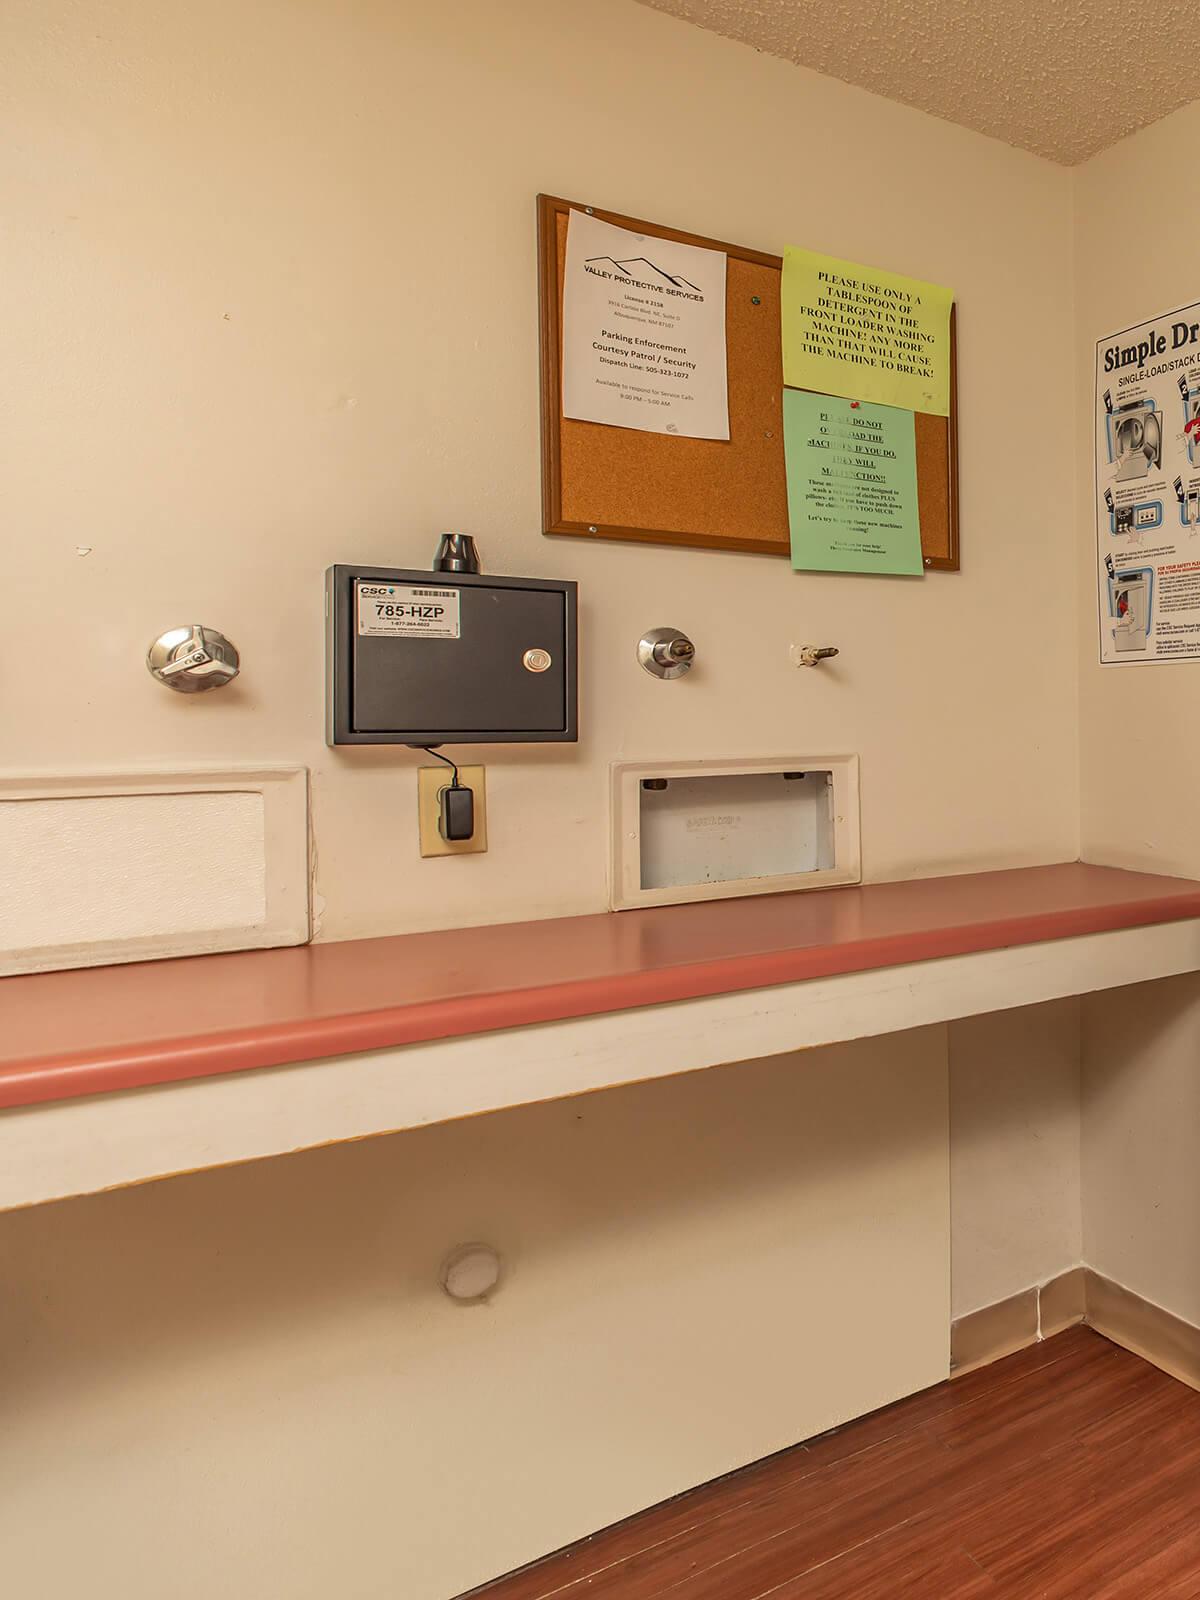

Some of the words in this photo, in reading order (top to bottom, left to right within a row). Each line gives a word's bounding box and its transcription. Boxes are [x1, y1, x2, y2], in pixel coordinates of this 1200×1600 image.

[584, 265, 612, 280] VALLEY
[614, 275, 664, 293] PROTECTIVE
[666, 288, 704, 302] SERVICES
[818, 272, 859, 289] PLEASE
[862, 282, 881, 295] USE
[884, 288, 912, 302] ONLY
[624, 294, 644, 304] License
[818, 297, 883, 320] DETERGENT
[886, 314, 896, 323] IN
[900, 317, 919, 328] THE
[826, 286, 896, 310] TABLESPOON
[899, 304, 912, 314] OF
[801, 306, 837, 321] FRONT
[841, 316, 884, 332] LOADER
[886, 325, 935, 343] WASHING
[812, 321, 866, 341] MACHINE!
[870, 335, 890, 345] ANY
[894, 339, 924, 353] MORE
[592, 342, 629, 357] Courtesy
[631, 350, 655, 361] Patrol
[663, 357, 696, 370] Security
[601, 330, 633, 344] Parking
[635, 338, 686, 354] Enforcement
[804, 331, 834, 345] THAN
[837, 338, 866, 352] THAT
[869, 346, 896, 359] WILL
[898, 352, 931, 366] CAUSE
[1104, 330, 1166, 372] Simple
[600, 356, 628, 368] Dispatch
[629, 363, 644, 371] Line:
[646, 366, 689, 379] 505-323-1072
[801, 343, 824, 356] THE
[827, 349, 877, 367] MACHINE
[880, 360, 894, 369] TO
[896, 364, 934, 378] BREAK!
[1118, 353, 1196, 387] SINGLE-LOAD/STACK
[1181, 384, 1188, 394] 2
[866, 420, 883, 429] NOT
[867, 434, 884, 443] THE
[864, 446, 881, 455] YOU
[360, 587, 387, 595] CSC
[375, 604, 444, 618] 785-HZP
